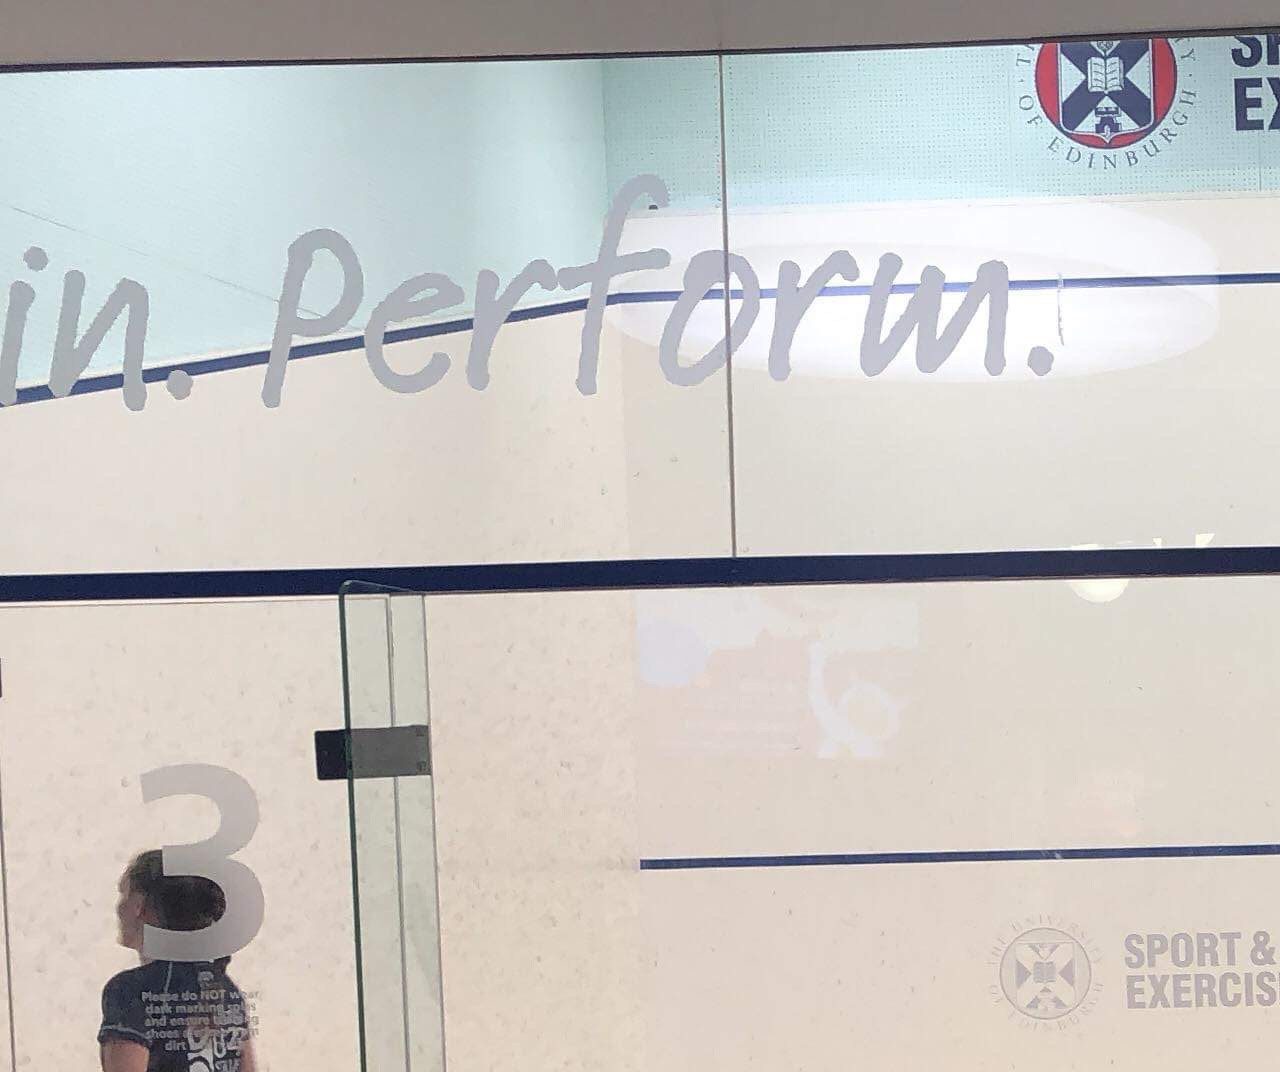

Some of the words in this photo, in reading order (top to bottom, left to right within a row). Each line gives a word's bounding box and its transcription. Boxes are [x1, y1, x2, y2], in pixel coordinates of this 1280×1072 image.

[1047, 89, 1198, 170] EDINBURGH
[261, 173, 1055, 409] Perform.
[139, 763, 265, 963] 3
[1123, 931, 1242, 970] SPORT
[1249, 930, 1277, 967] &
